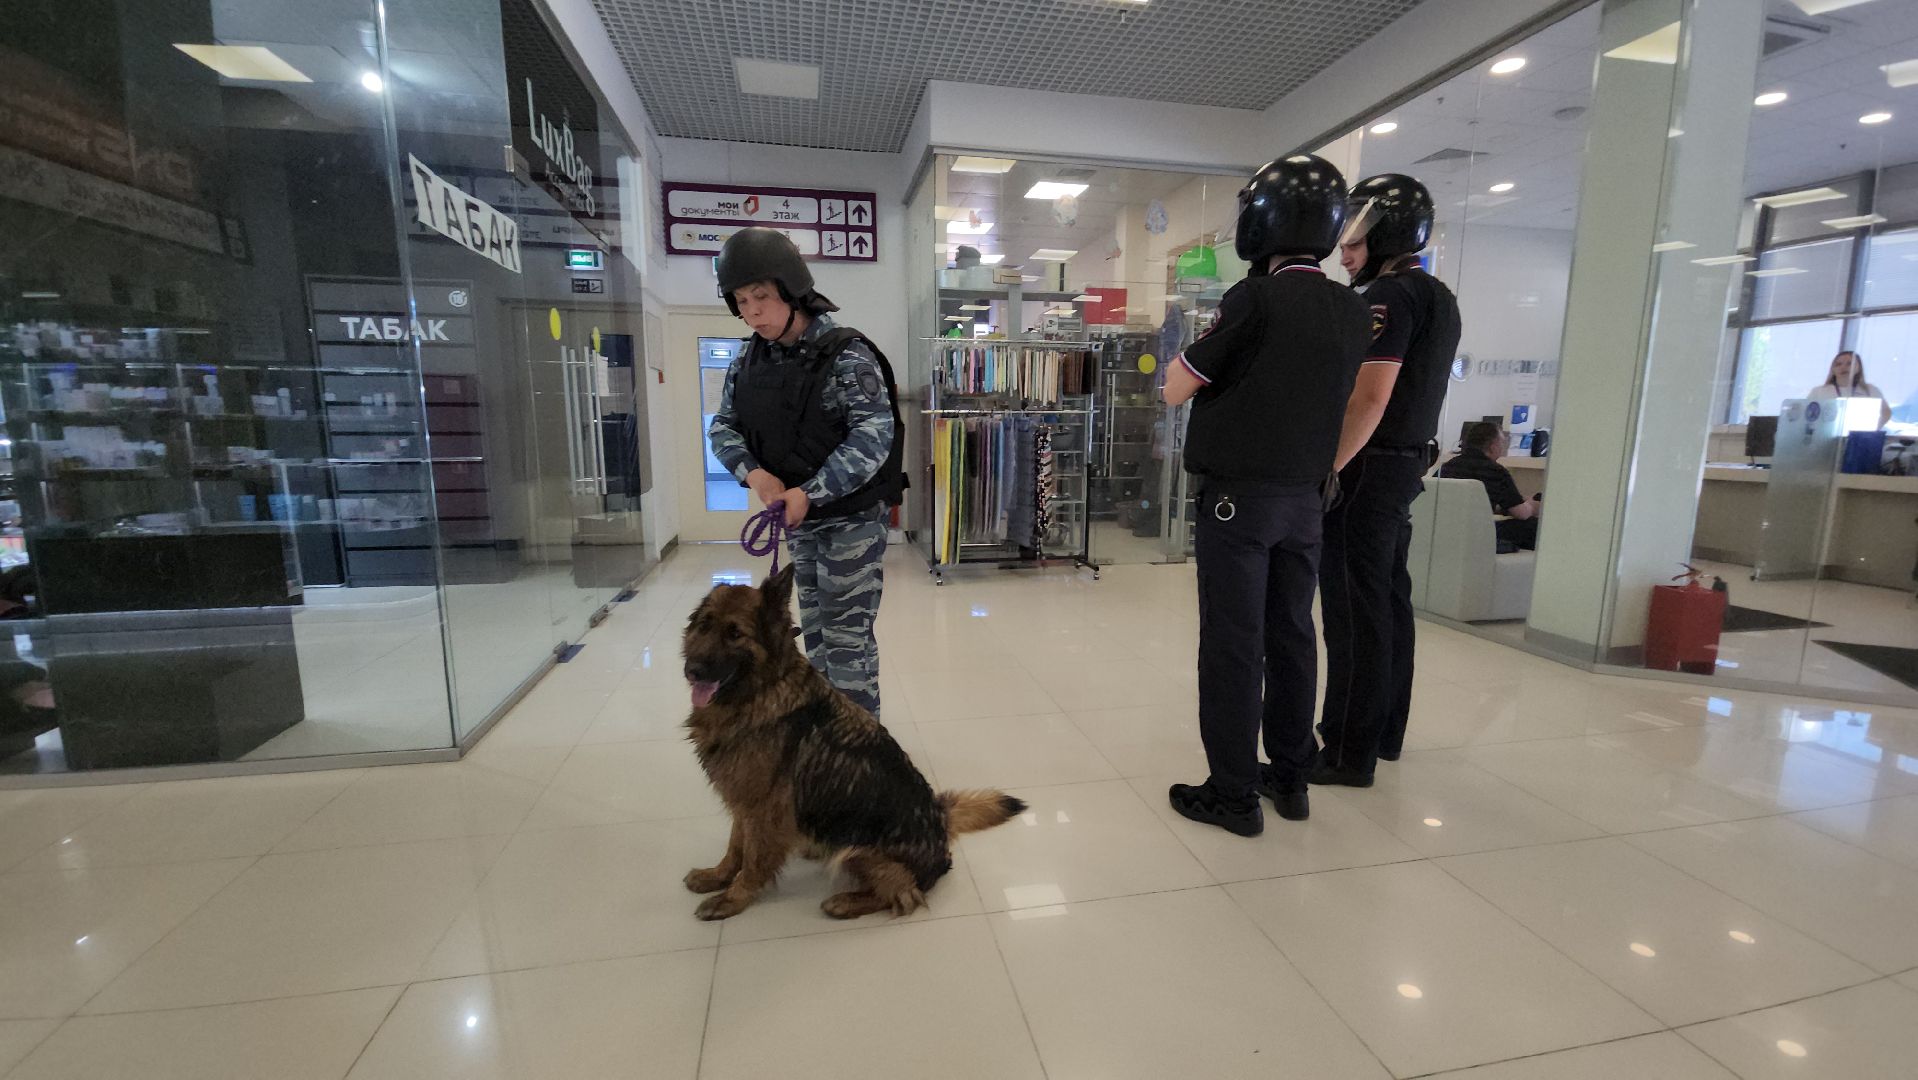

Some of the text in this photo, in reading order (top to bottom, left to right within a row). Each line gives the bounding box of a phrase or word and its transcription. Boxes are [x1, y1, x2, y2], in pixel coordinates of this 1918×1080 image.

[526, 77, 595, 217] LuxBag
[772, 211, 800, 220] этаж
[782, 199, 790, 209] 4
[415, 163, 519, 271] ТАБАК
[339, 316, 449, 341] ТАБАК
